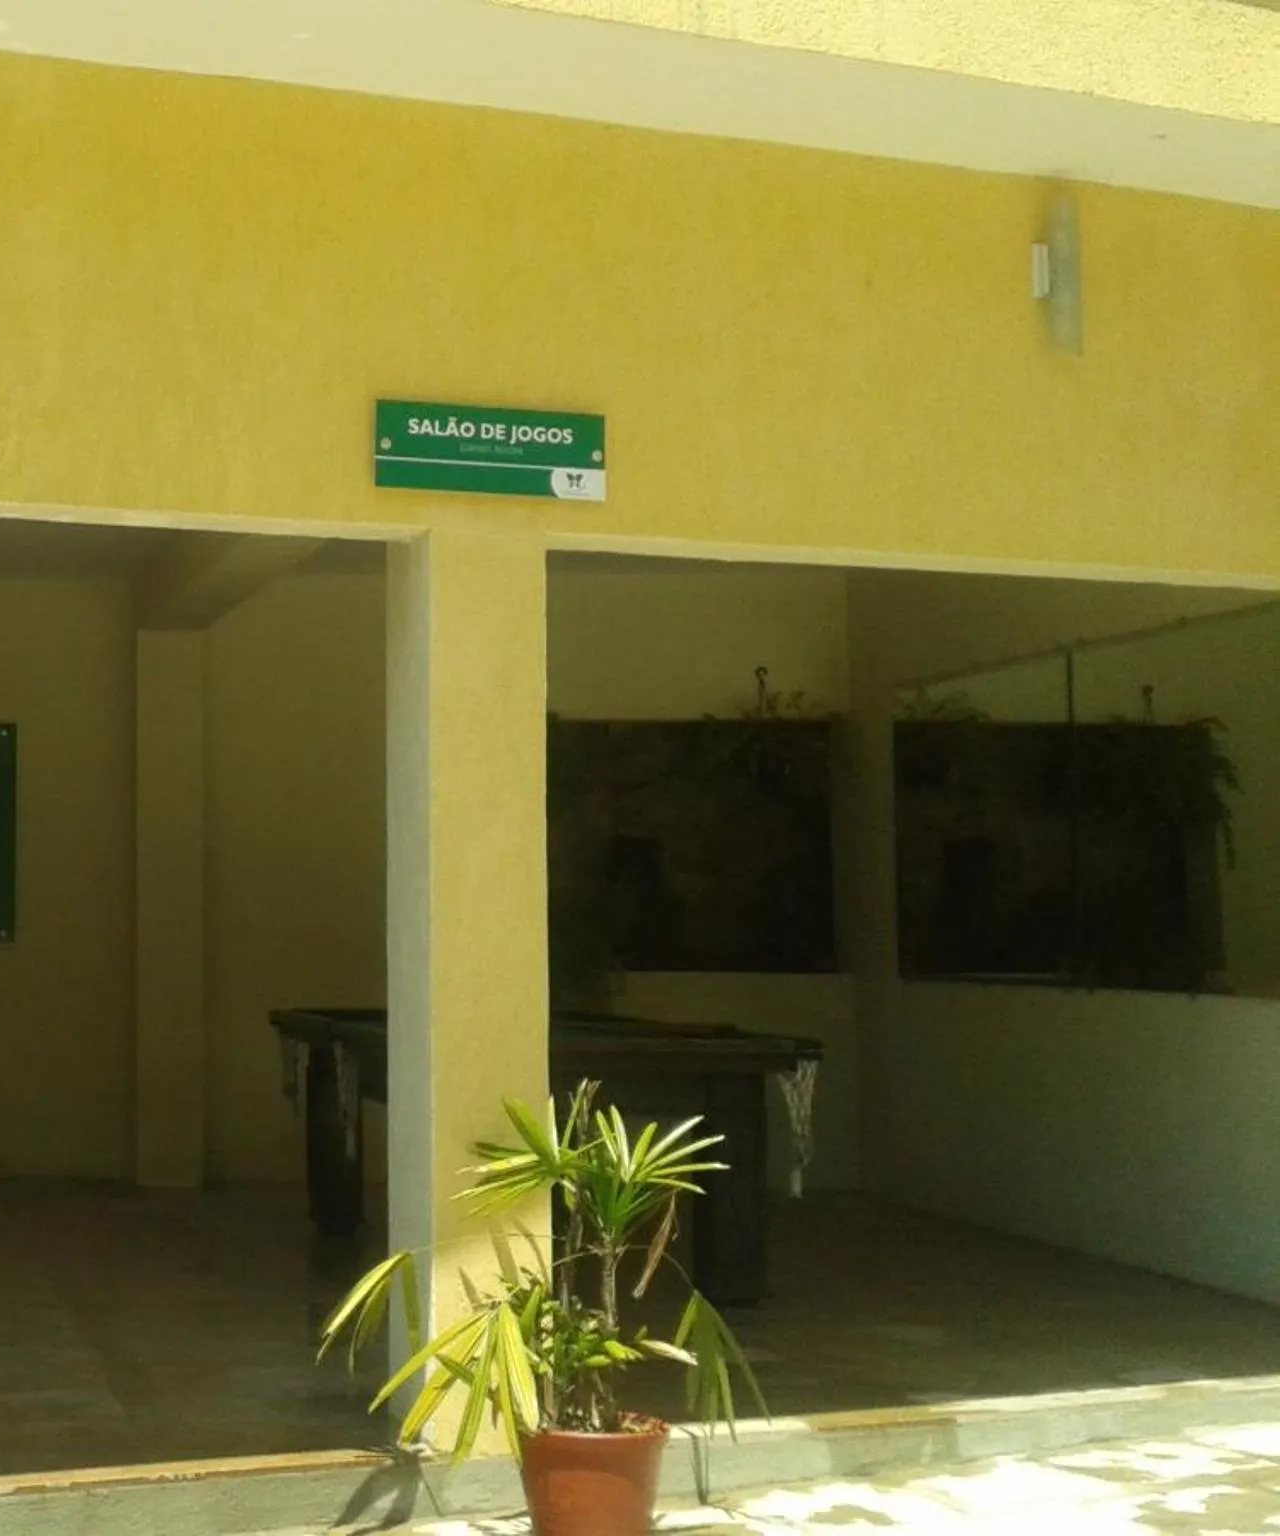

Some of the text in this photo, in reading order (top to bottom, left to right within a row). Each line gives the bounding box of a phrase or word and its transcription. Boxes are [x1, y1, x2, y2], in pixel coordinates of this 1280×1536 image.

[408, 417, 574, 446] SALÃO DE JOGOS
